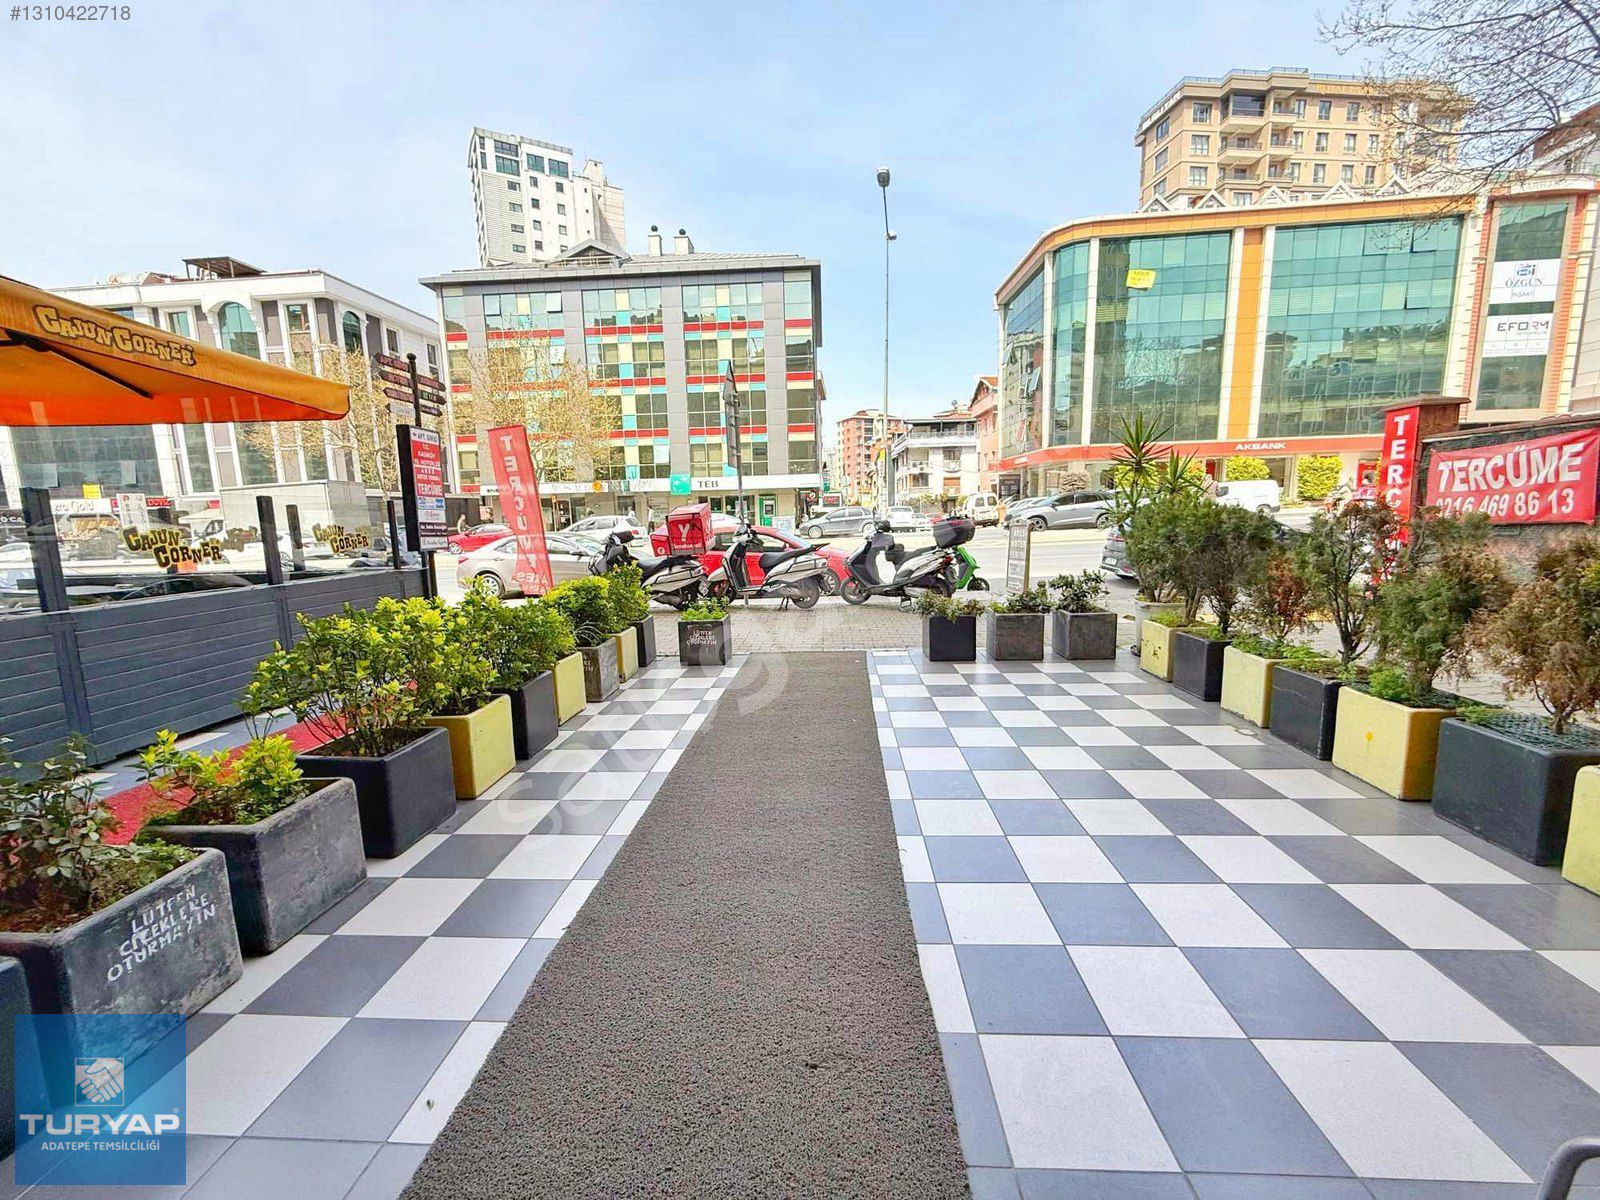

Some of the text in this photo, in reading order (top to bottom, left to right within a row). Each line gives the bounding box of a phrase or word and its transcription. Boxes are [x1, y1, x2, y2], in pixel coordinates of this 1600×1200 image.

[33, 305, 197, 366] CAJUN CORNER
[1497, 321, 1550, 332] EFORM
[1235, 442, 1287, 451] AKBANK
[1438, 442, 1585, 493] TERCÜME
[698, 480, 719, 488] TEB
[1478, 493, 1510, 517] 469
[1514, 491, 1540, 516] 86
[1547, 488, 1575, 515] 13
[122, 526, 181, 552] CAJUN
[330, 532, 369, 554] CORNER
[154, 541, 222, 568] CORNER
[107, 904, 216, 983] OTURMAYIN
